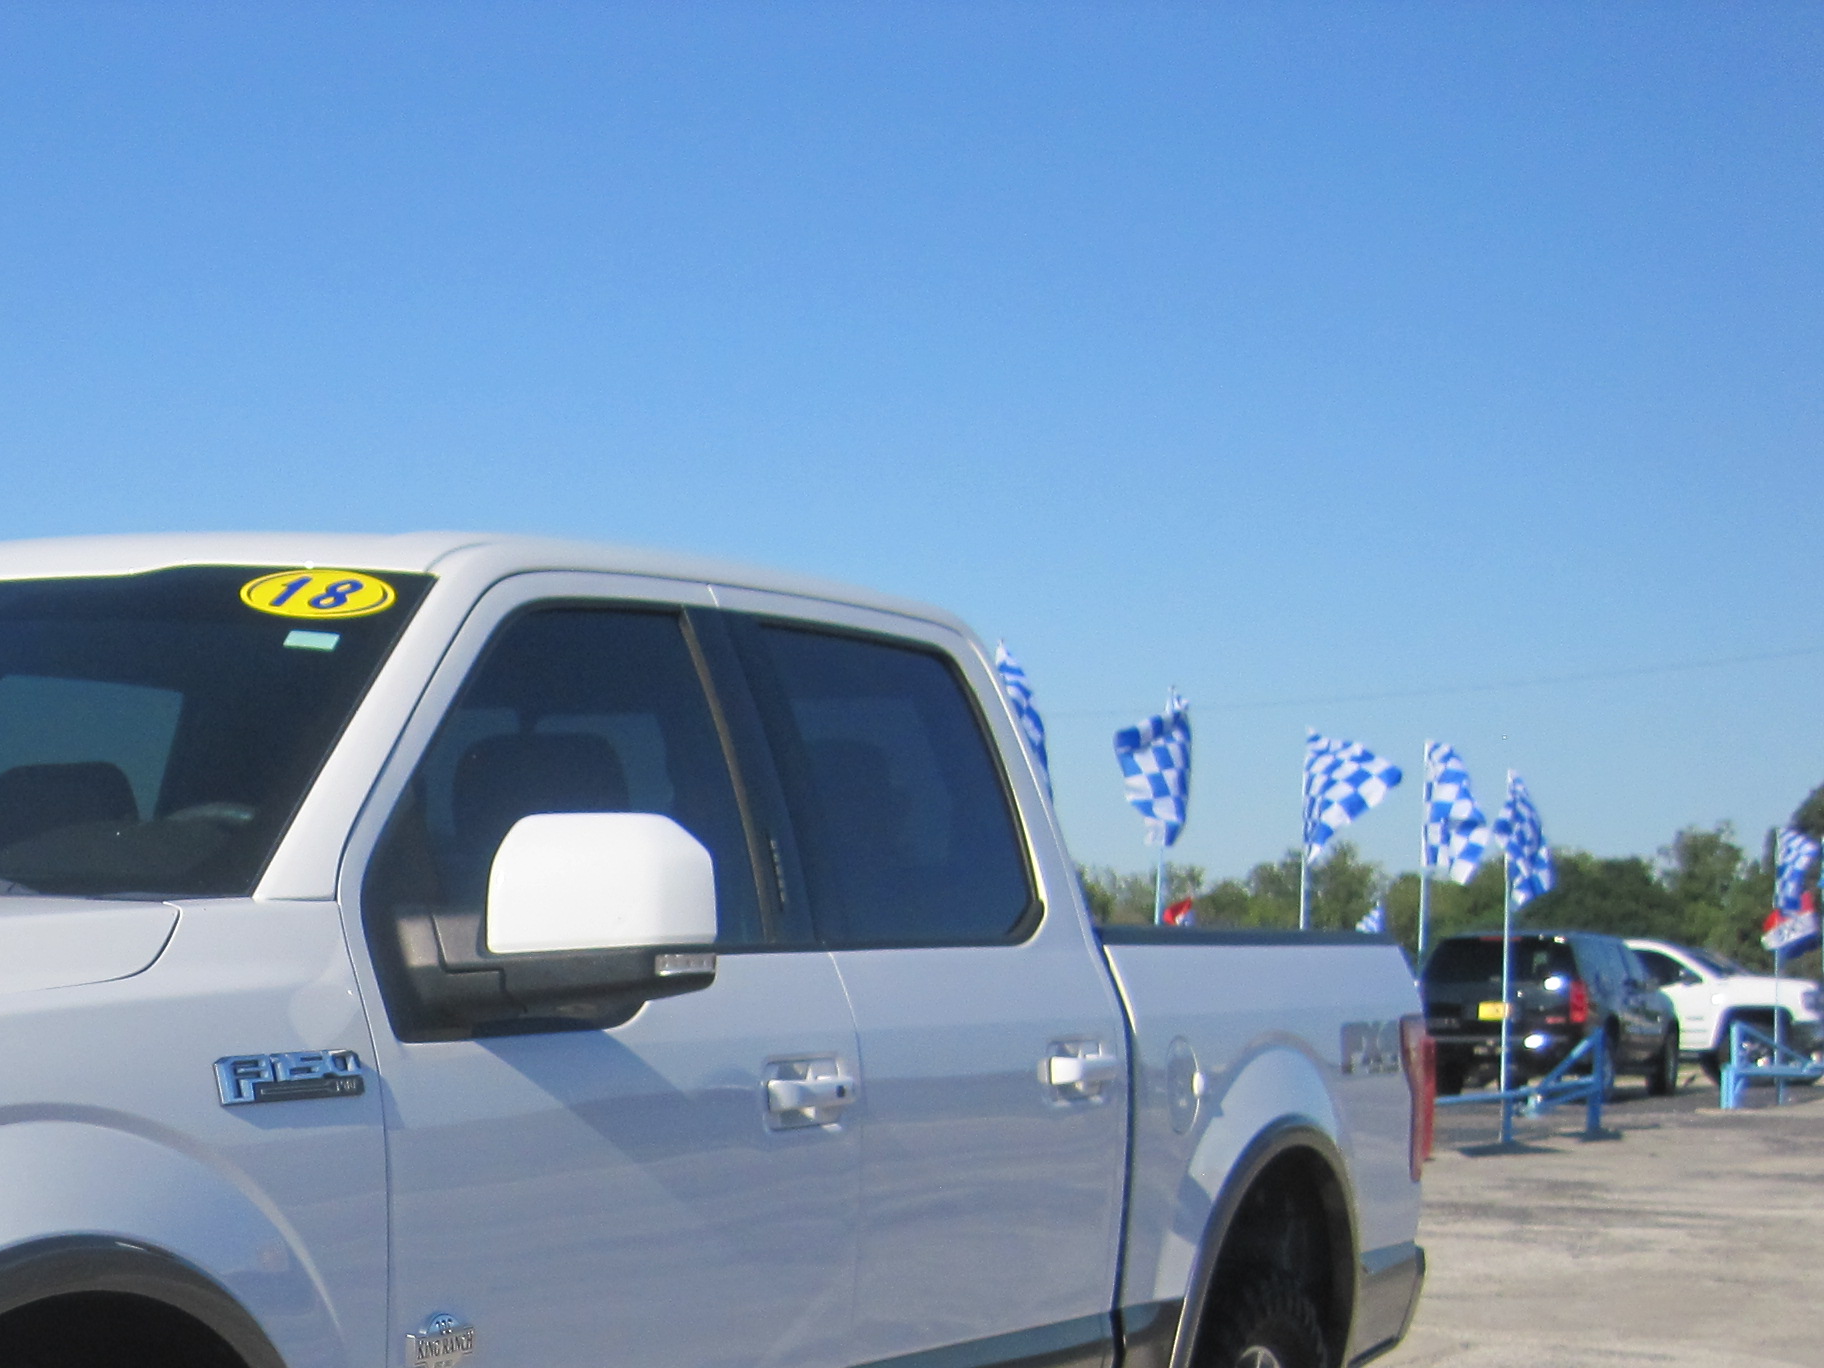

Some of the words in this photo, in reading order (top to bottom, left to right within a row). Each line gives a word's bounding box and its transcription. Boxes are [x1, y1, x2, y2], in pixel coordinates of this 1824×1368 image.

[269, 576, 364, 609] 18
[417, 1340, 440, 1360] KING
[442, 1330, 474, 1354] RANCH
